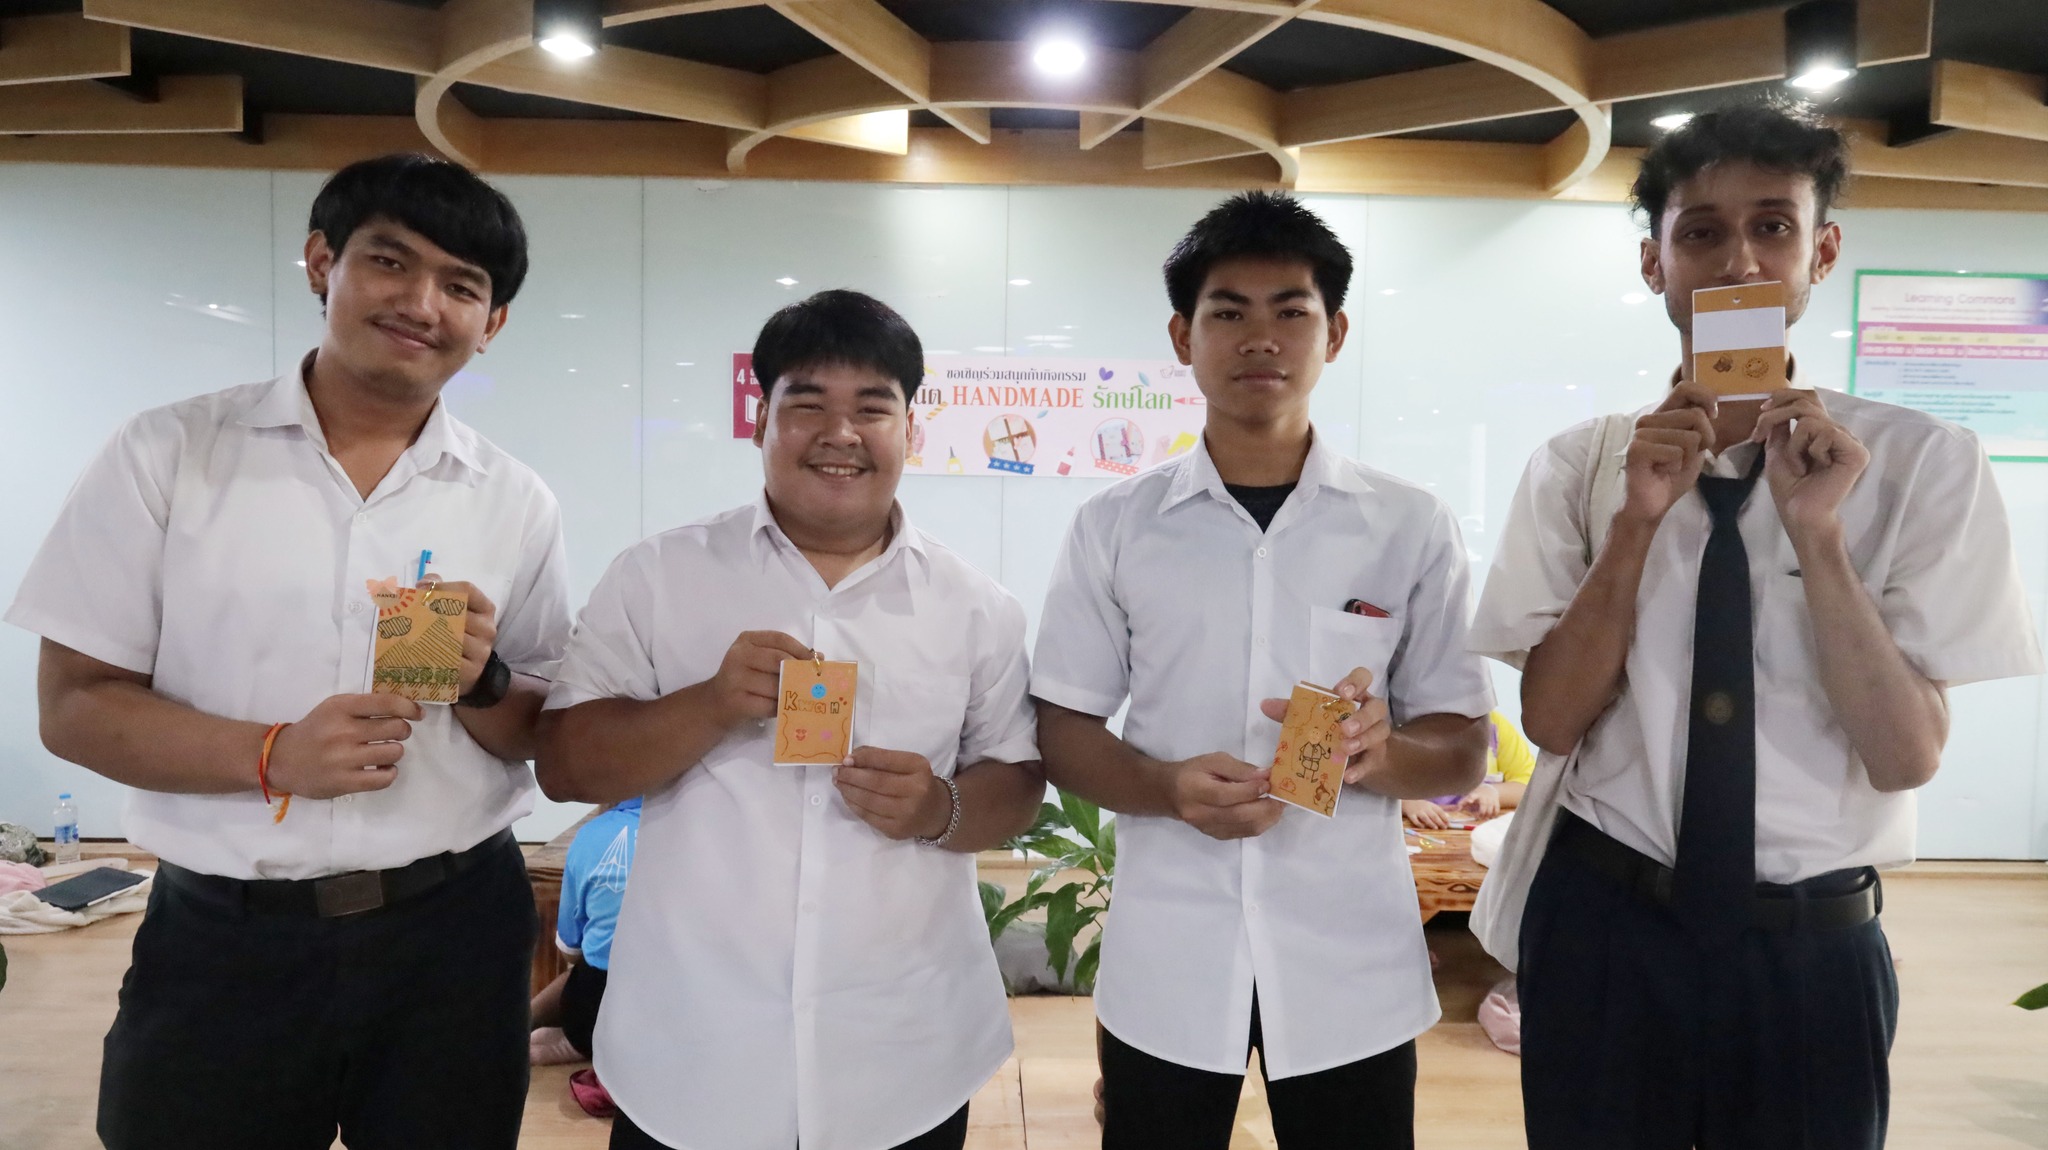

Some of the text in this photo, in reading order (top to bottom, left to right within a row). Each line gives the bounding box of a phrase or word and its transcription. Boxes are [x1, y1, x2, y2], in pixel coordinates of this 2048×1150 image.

[1904, 293, 2016, 306] Learning Commons
[736, 368, 745, 385] 4
[946, 367, 1087, 384] ขอเชิญร่วมสนุกกับกิจกรรม
[952, 385, 1084, 408] HANDMADE
[1092, 384, 1172, 410] รักษ์โลก
